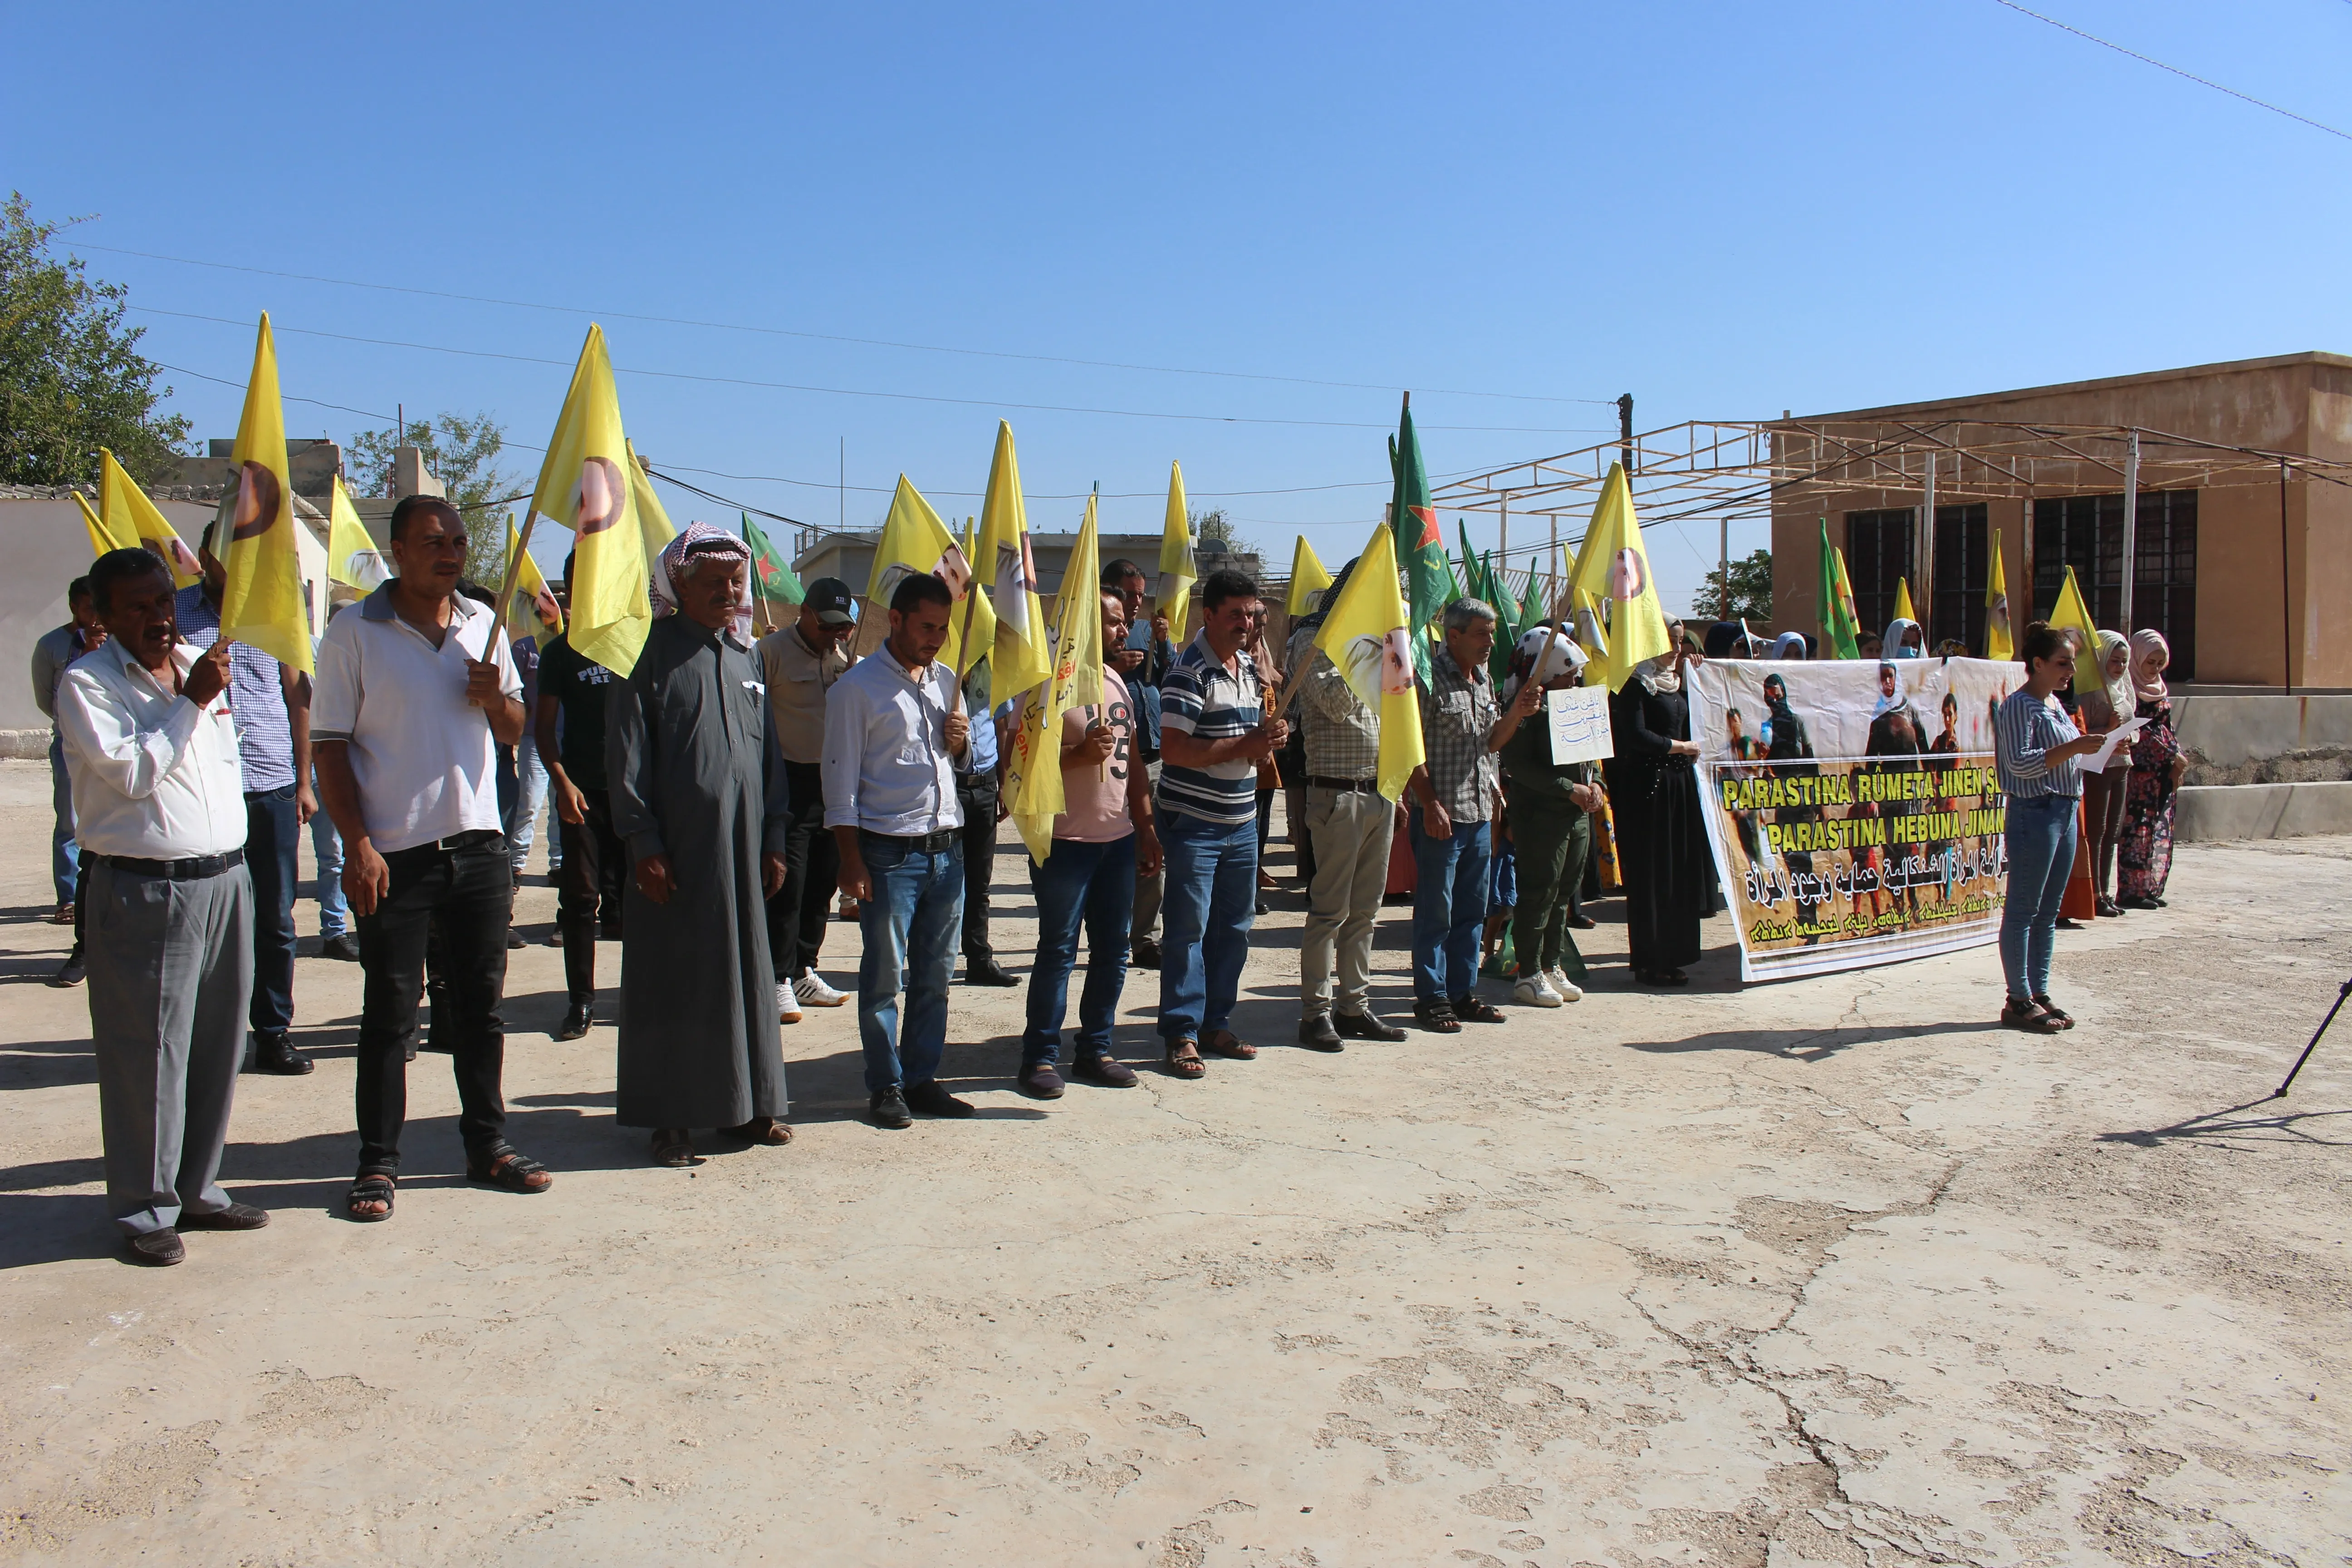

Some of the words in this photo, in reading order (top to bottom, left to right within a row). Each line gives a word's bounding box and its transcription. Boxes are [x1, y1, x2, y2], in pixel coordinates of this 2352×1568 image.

[577, 665, 611, 681] PUE
[590, 675, 610, 685] RI
[1722, 774, 1852, 811] PARASTINA
[1857, 764, 1935, 803] RÛMETA
[1939, 760, 1982, 798] JINÊN
[1767, 817, 1886, 853] PARASTINA
[1893, 805, 1961, 844] HEBÛNA
[1744, 861, 1788, 909] المرأة
[1834, 862, 1880, 902] حماية
[1883, 852, 1948, 896] الشنكالية
[1950, 843, 1979, 887] المرأة
[1790, 871, 1833, 906] وجود
